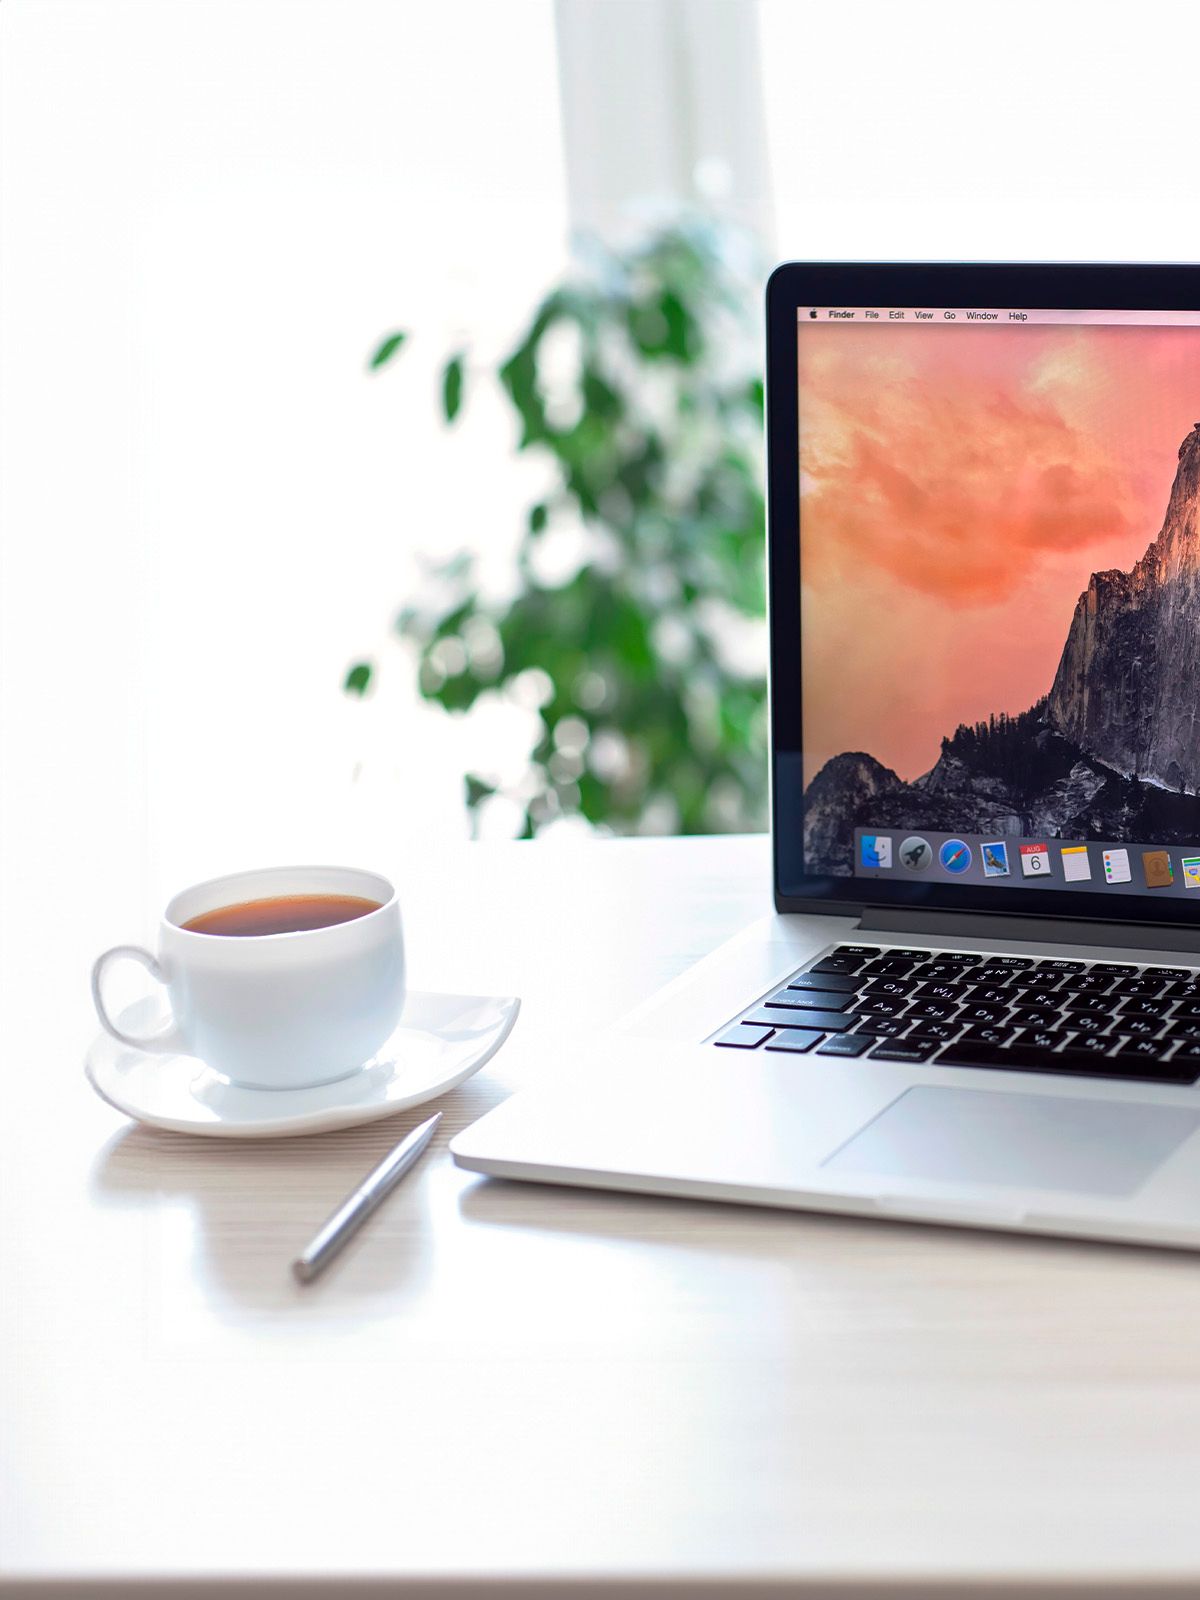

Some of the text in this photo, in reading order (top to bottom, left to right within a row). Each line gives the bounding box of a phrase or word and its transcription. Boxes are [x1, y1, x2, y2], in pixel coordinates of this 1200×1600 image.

[829, 310, 855, 319] Finder
[865, 311, 879, 319] File
[889, 311, 905, 319] Edit
[966, 312, 998, 320] Window
[1009, 312, 1028, 321] Help
[1026, 845, 1041, 853] AUG
[1031, 855, 1041, 870] 6
